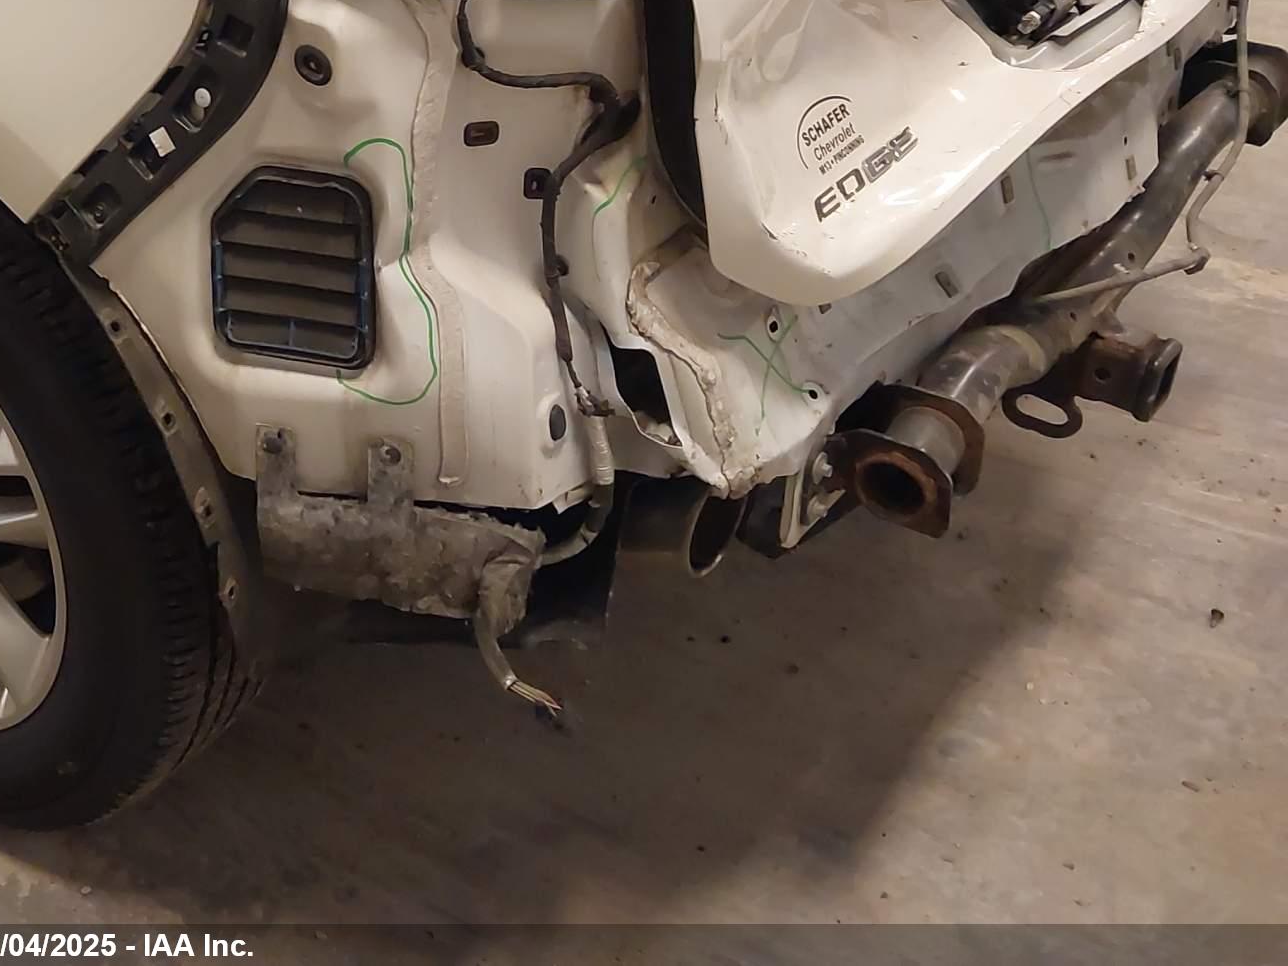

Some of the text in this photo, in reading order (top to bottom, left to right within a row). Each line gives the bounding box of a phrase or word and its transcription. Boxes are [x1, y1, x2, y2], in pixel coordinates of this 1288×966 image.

[802, 103, 850, 147] SCHAFER
[813, 122, 856, 161] Chevrolet
[814, 126, 918, 222] EDGE
